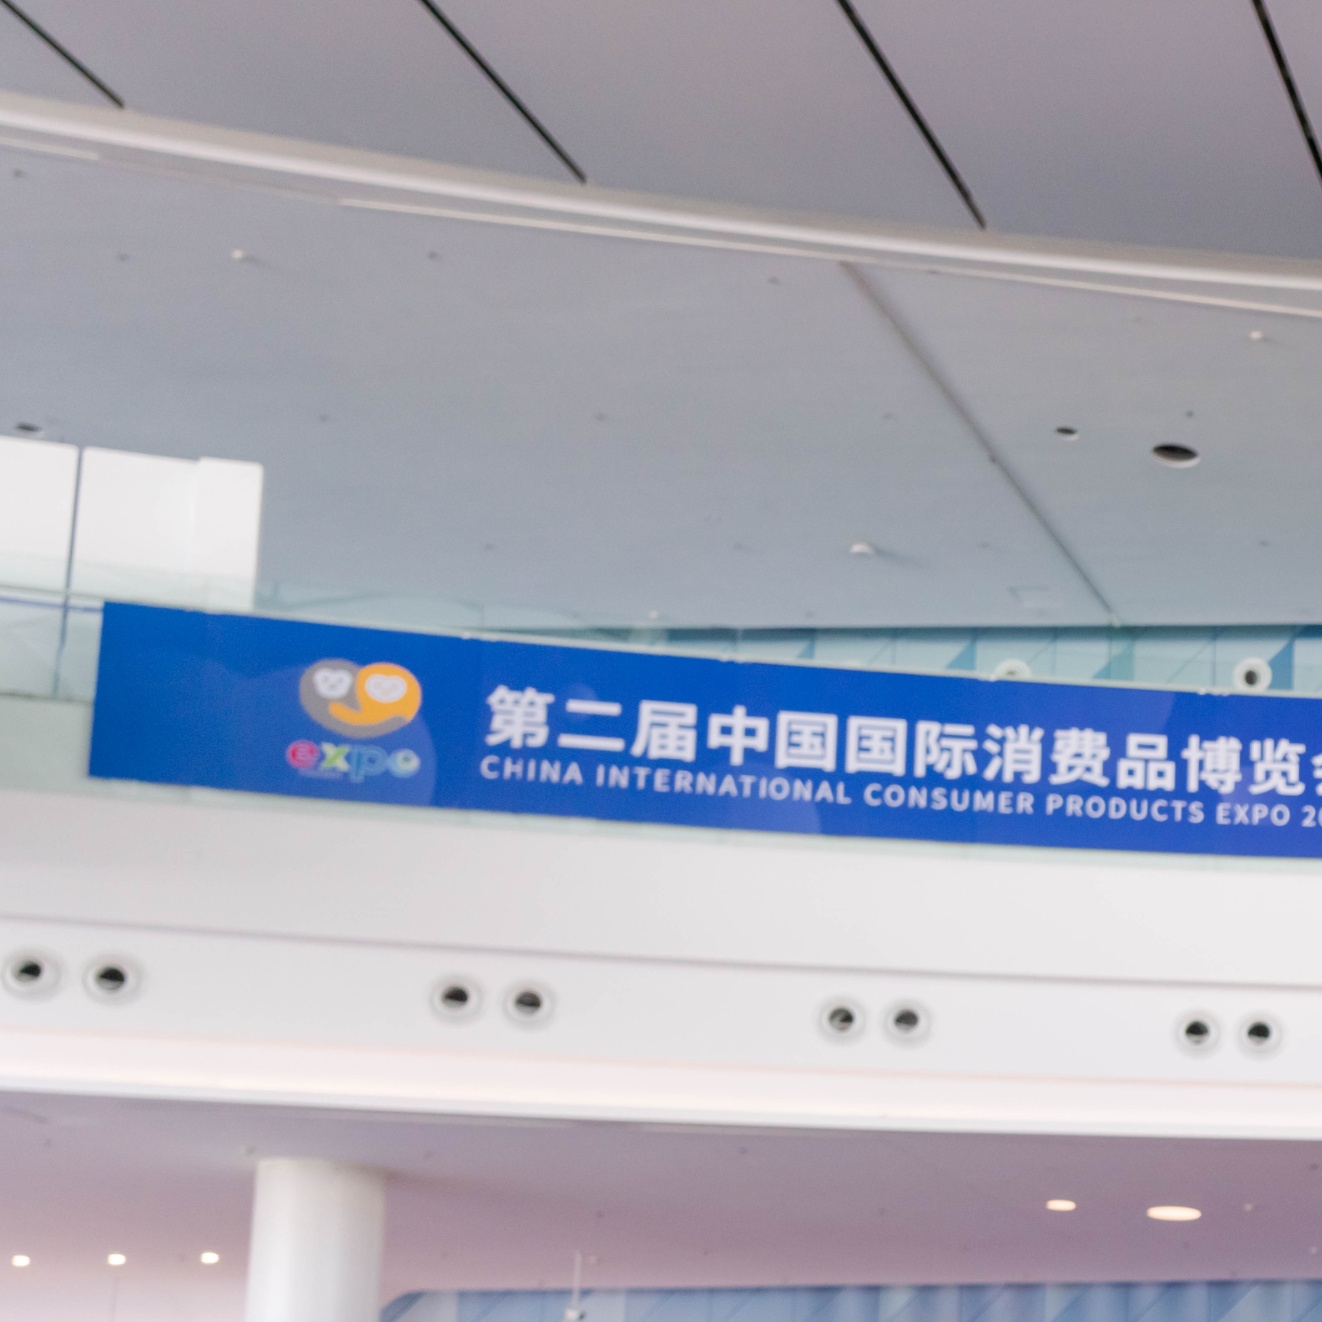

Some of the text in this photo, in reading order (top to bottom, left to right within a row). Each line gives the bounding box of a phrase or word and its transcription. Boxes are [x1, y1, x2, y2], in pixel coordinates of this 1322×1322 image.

[285, 739, 421, 784] expo
[479, 754, 583, 786] CHINA
[595, 763, 853, 805] INTERNATIONAL
[863, 782, 1035, 817] CONSUMER
[1045, 791, 1206, 825] PRODUCTS
[1214, 801, 1292, 828] EXPO
